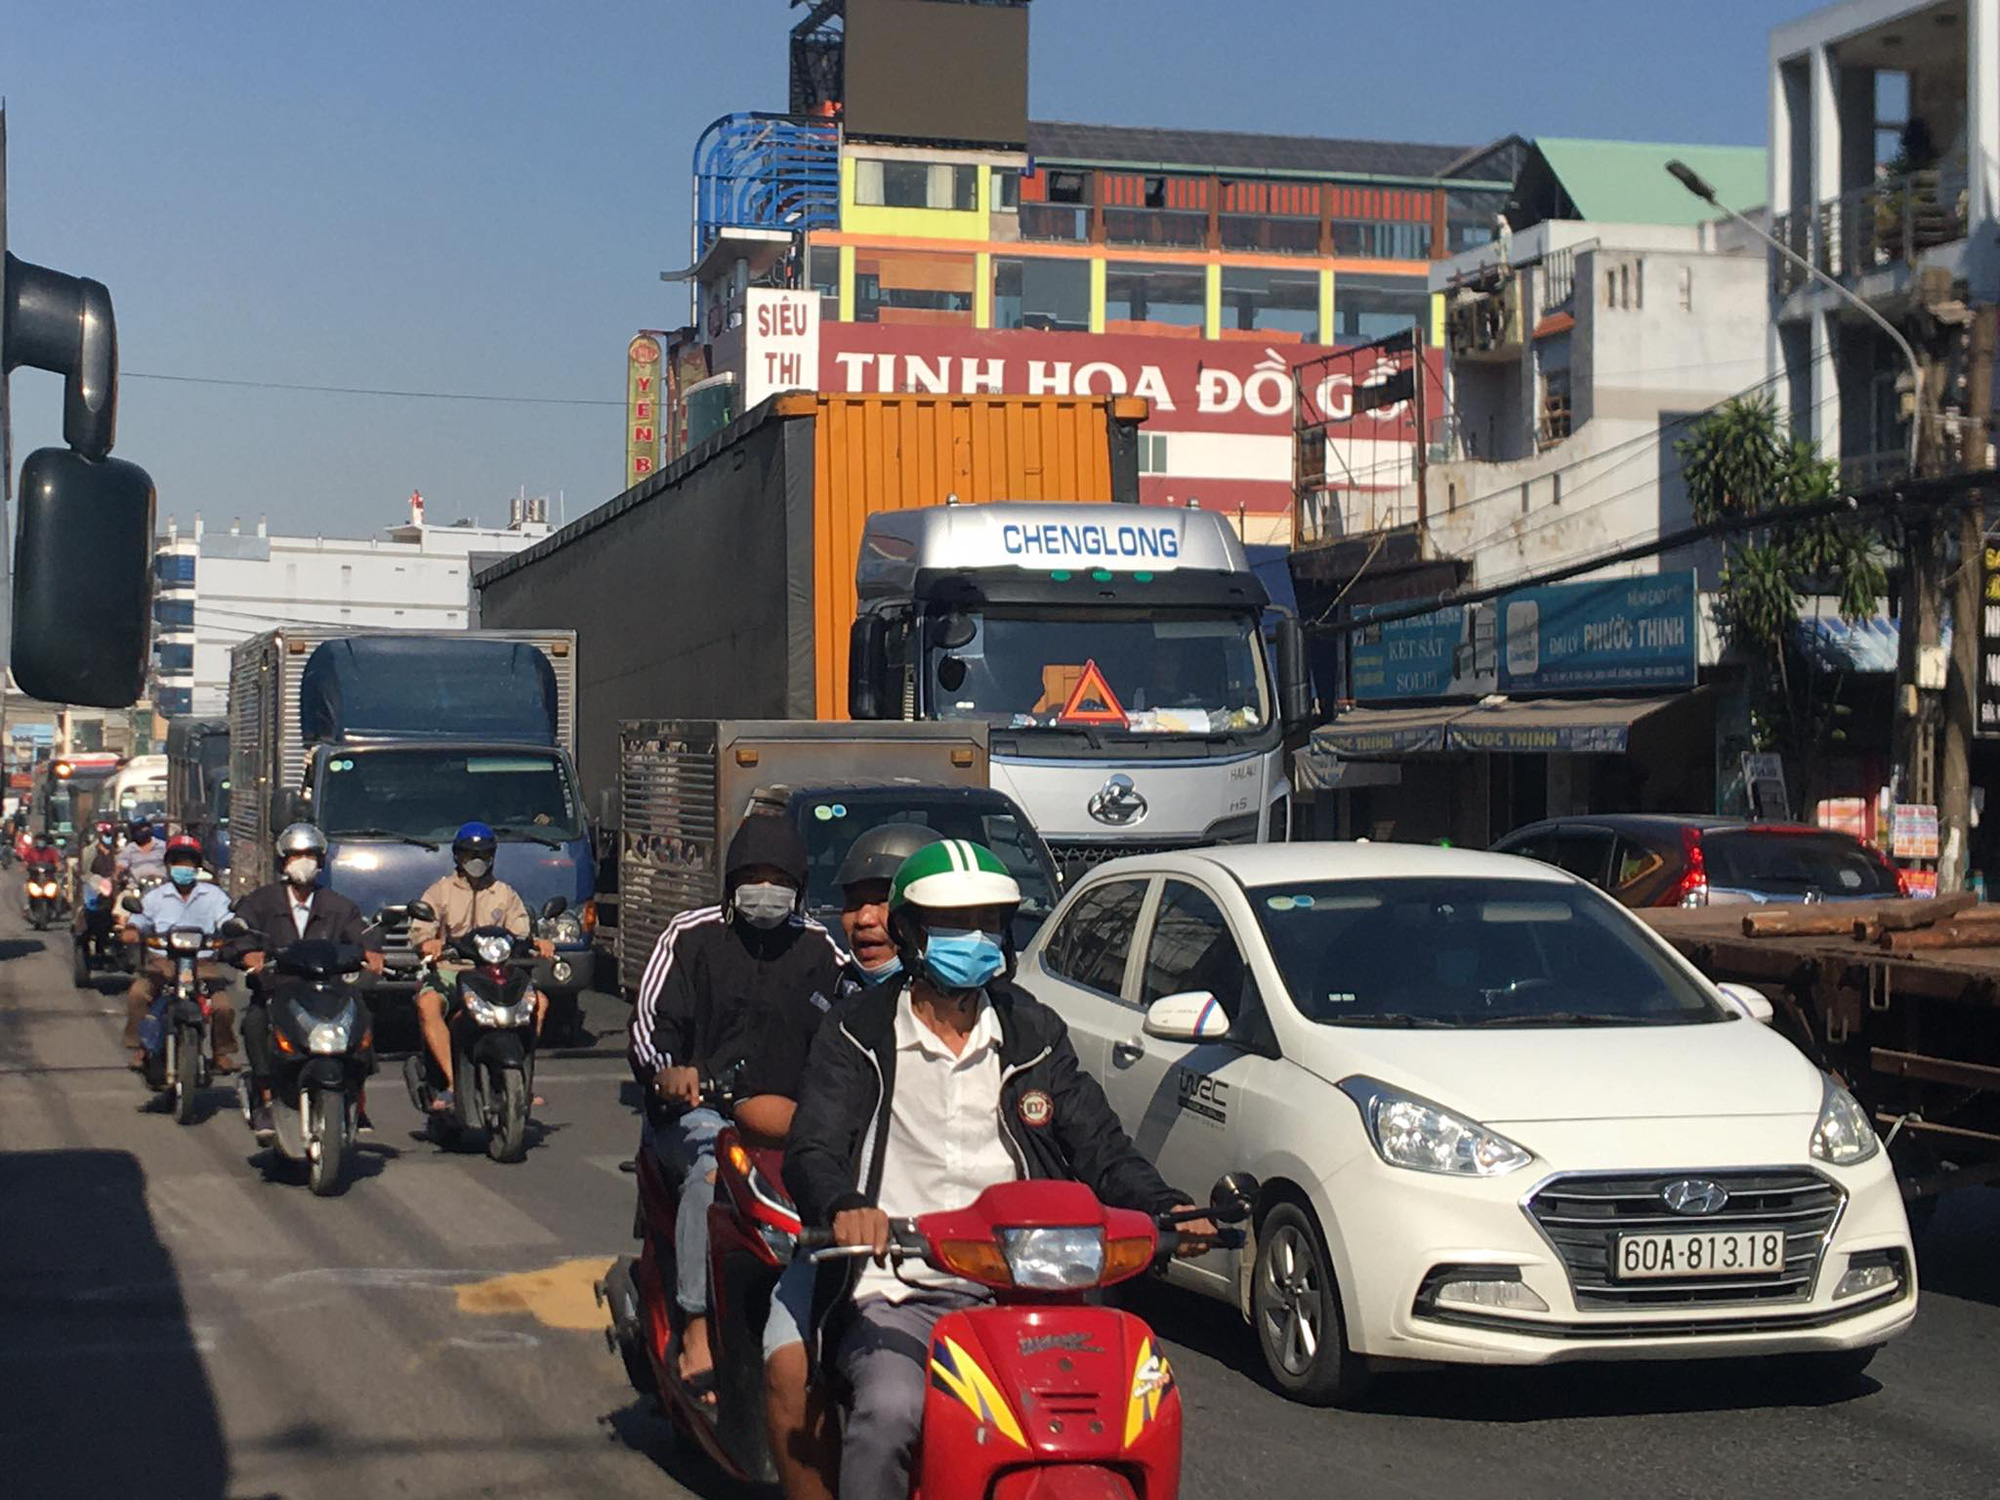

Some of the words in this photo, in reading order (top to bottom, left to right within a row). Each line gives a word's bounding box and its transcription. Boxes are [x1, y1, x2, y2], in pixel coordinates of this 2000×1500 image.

[757, 295, 807, 337] SIÊU
[835, 352, 1006, 394] TINH
[1027, 360, 1177, 412] HOA
[1195, 347, 1294, 416] ĐỒ
[1003, 524, 1179, 558] CHENGLONG
[1637, 616, 1685, 654] THỊNH
[1624, 1234, 1778, 1271] 60A-813.18
